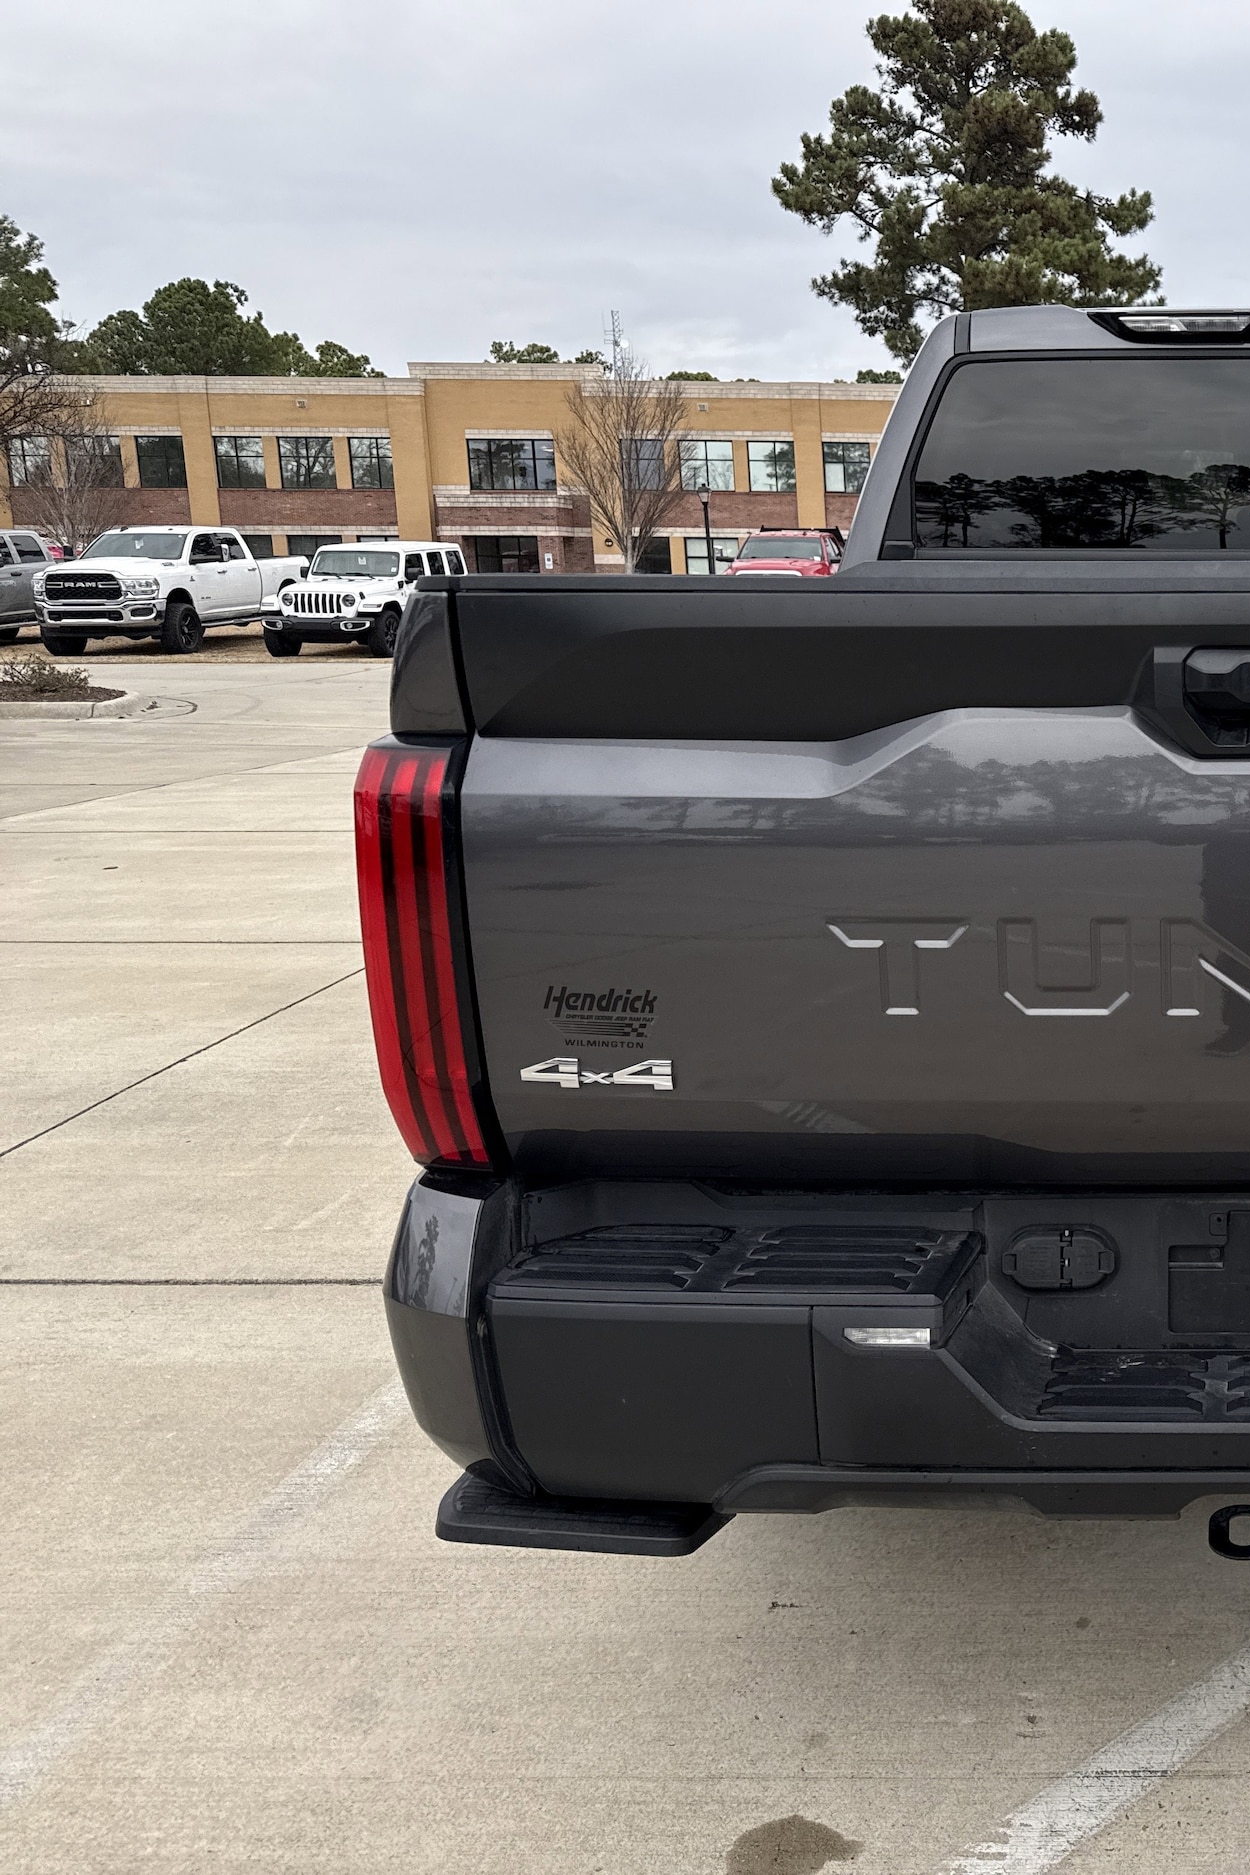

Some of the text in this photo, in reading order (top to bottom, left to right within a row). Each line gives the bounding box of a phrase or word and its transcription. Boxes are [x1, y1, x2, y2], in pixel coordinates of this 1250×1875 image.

[543, 985, 658, 1018] Hendrick
[565, 1038, 645, 1050] WILMINGTON
[520, 1057, 674, 1090] 4x4
